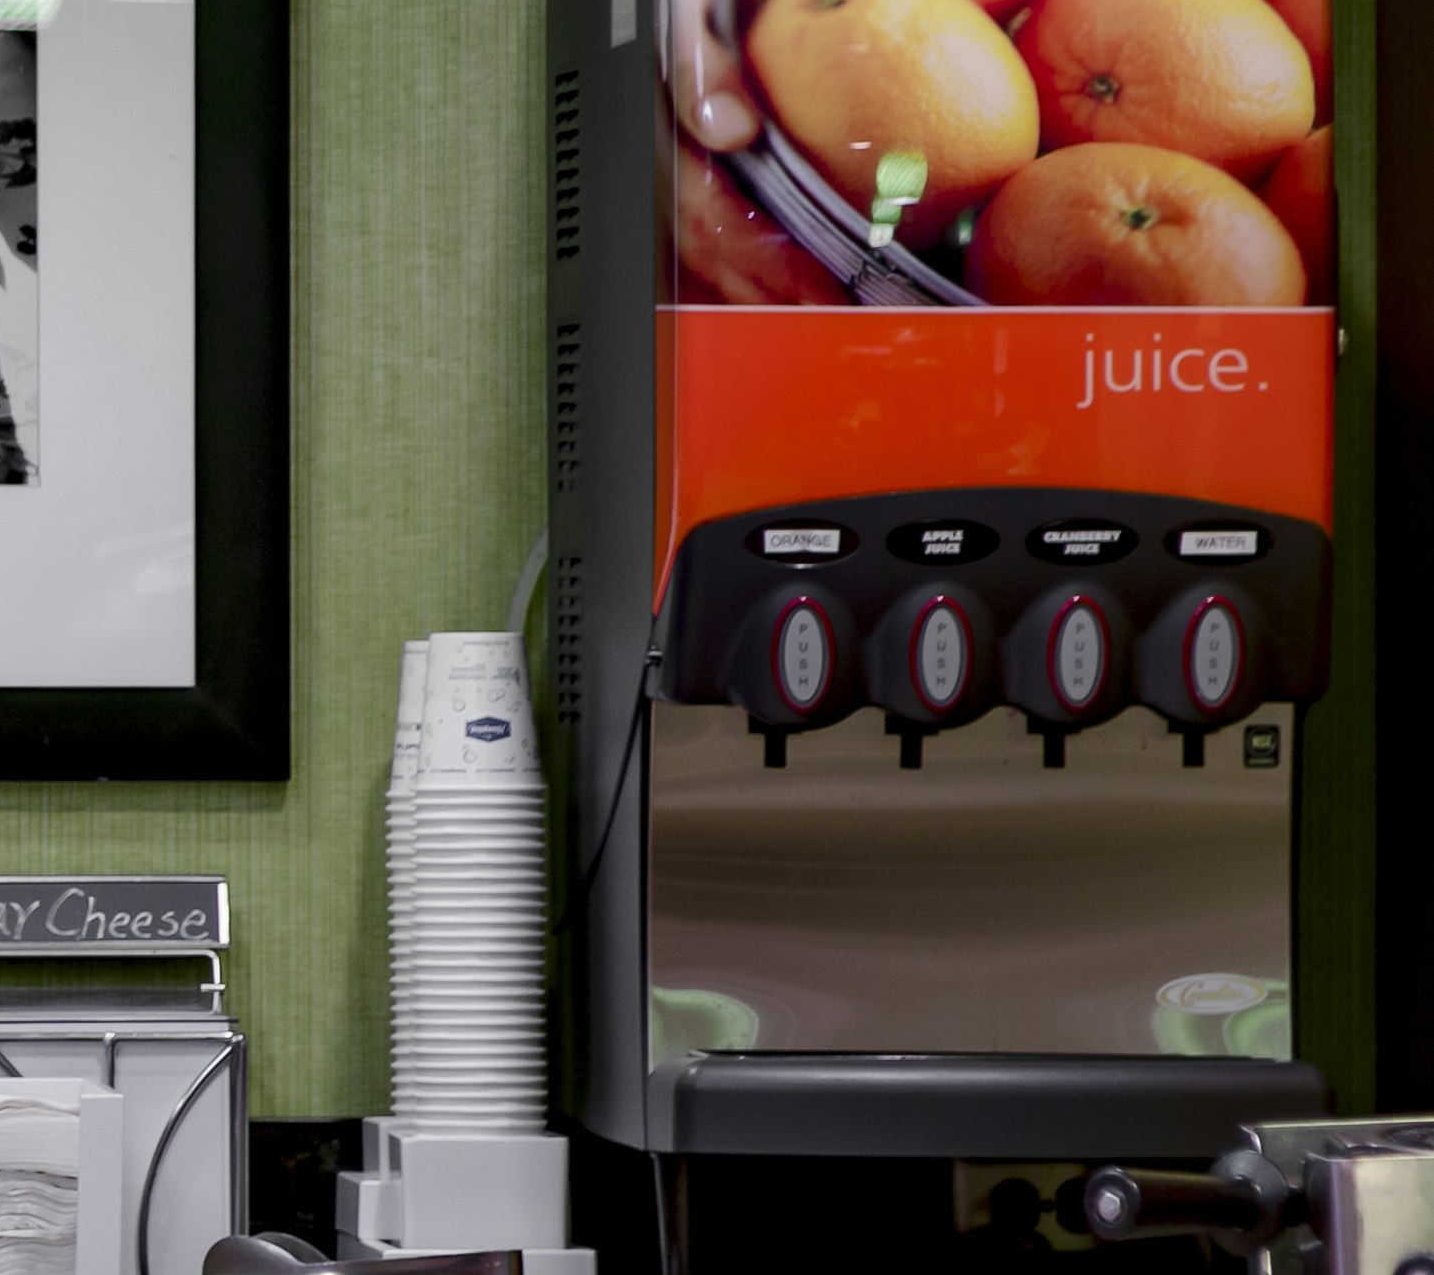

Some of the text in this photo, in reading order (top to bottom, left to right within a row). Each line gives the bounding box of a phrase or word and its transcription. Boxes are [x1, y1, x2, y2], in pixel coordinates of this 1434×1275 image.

[1076, 332, 1269, 410] juice.
[769, 533, 833, 548] ORANGE
[921, 530, 964, 543] APPLE
[923, 542, 961, 555] JUICE
[1063, 543, 1101, 555] JUICE
[1195, 536, 1247, 549] WATER
[798, 623, 810, 687] PUSH
[936, 623, 947, 687] PUSH
[1073, 623, 1086, 687] PUSH
[1208, 623, 1221, 687] PUSH
[46, 887, 211, 941] Cheese
